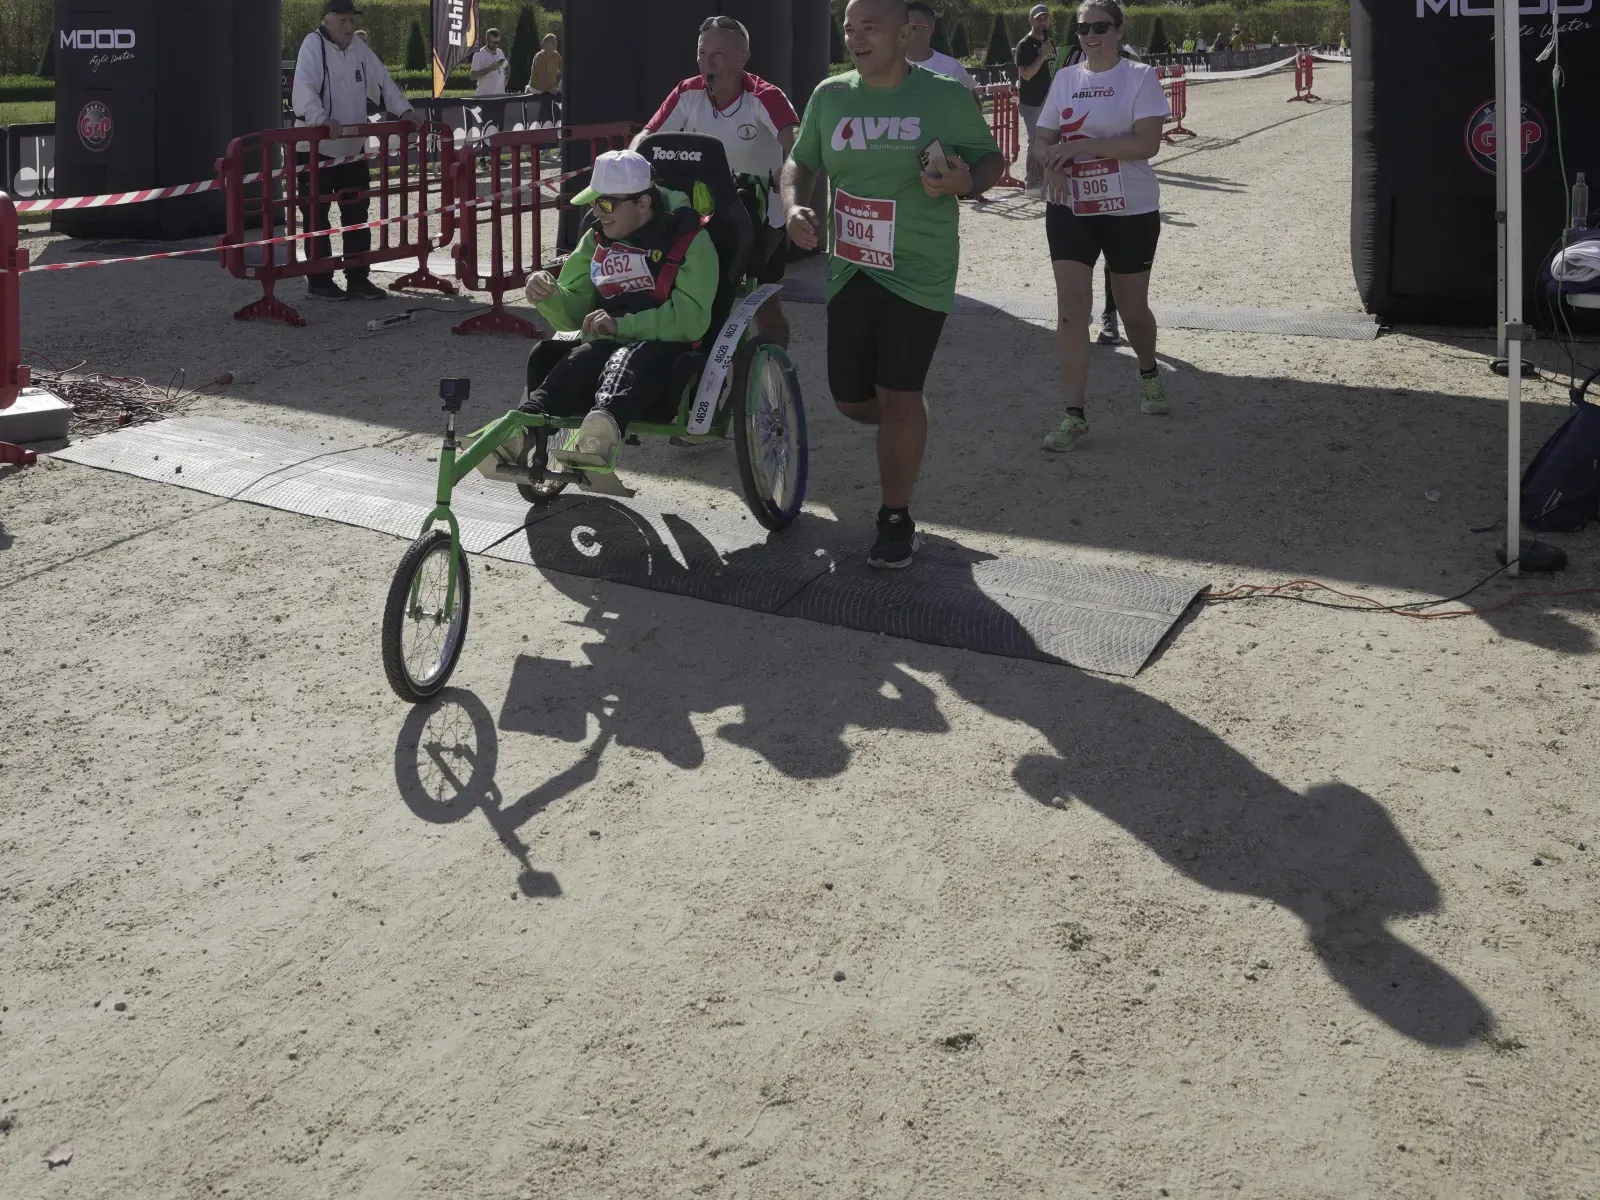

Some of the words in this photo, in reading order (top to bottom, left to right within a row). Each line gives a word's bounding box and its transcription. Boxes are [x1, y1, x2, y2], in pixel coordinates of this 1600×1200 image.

[60, 28, 136, 50] MOOD
[830, 116, 922, 152] AVIS
[1082, 178, 1109, 196] 906
[1098, 198, 1125, 212] 21K
[847, 219, 875, 242] 904
[860, 249, 891, 267] 21K
[619, 276, 653, 293] 21K
[714, 344, 729, 365] 4628
[694, 400, 710, 425] 4628
